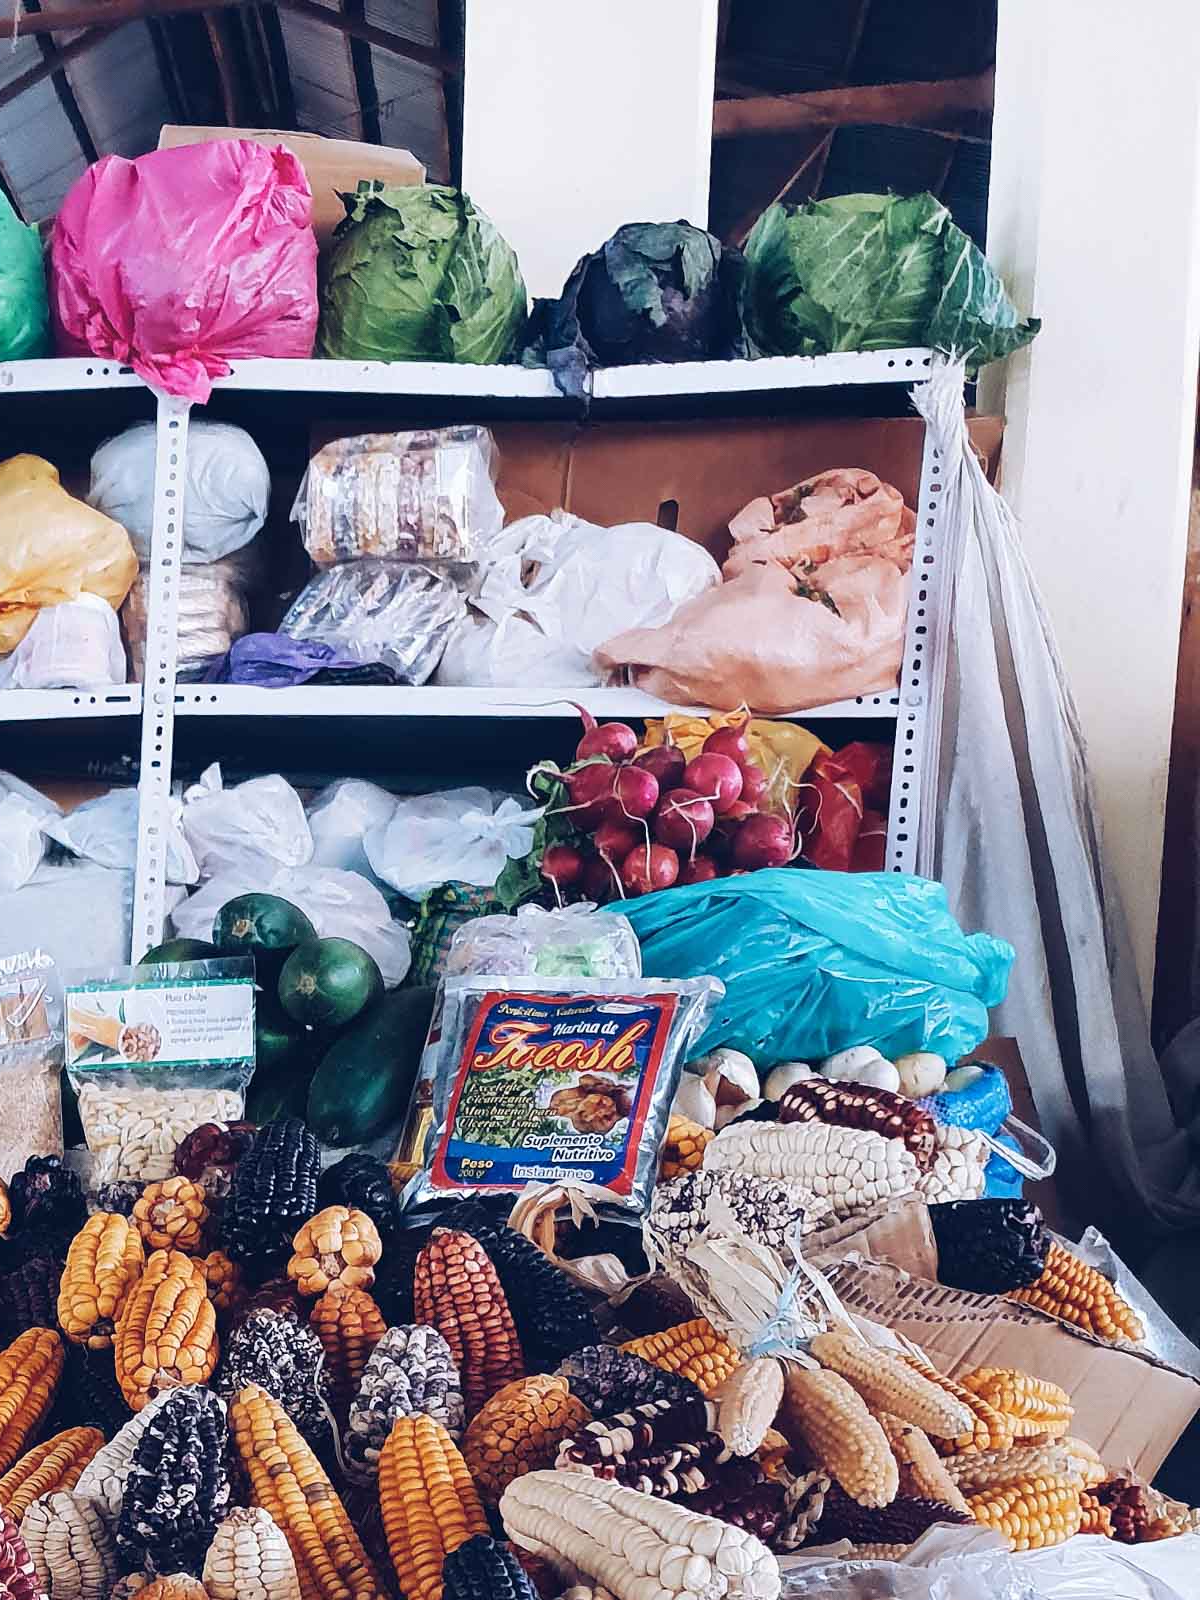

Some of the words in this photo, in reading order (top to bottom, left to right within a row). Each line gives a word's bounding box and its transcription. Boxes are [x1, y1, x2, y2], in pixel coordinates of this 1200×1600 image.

[552, 1021, 599, 1037] Harina
[601, 1020, 620, 1035] de
[473, 1019, 652, 1072] Tocosh
[469, 1082, 523, 1093] Excelente
[490, 1105, 525, 1116] bueno
[528, 1107, 557, 1121] para
[524, 1135, 603, 1149] Suplemento
[553, 1149, 615, 1162] Nutritivo
[461, 1158, 494, 1169] Peso
[512, 1164, 594, 1180] Instantaneo
